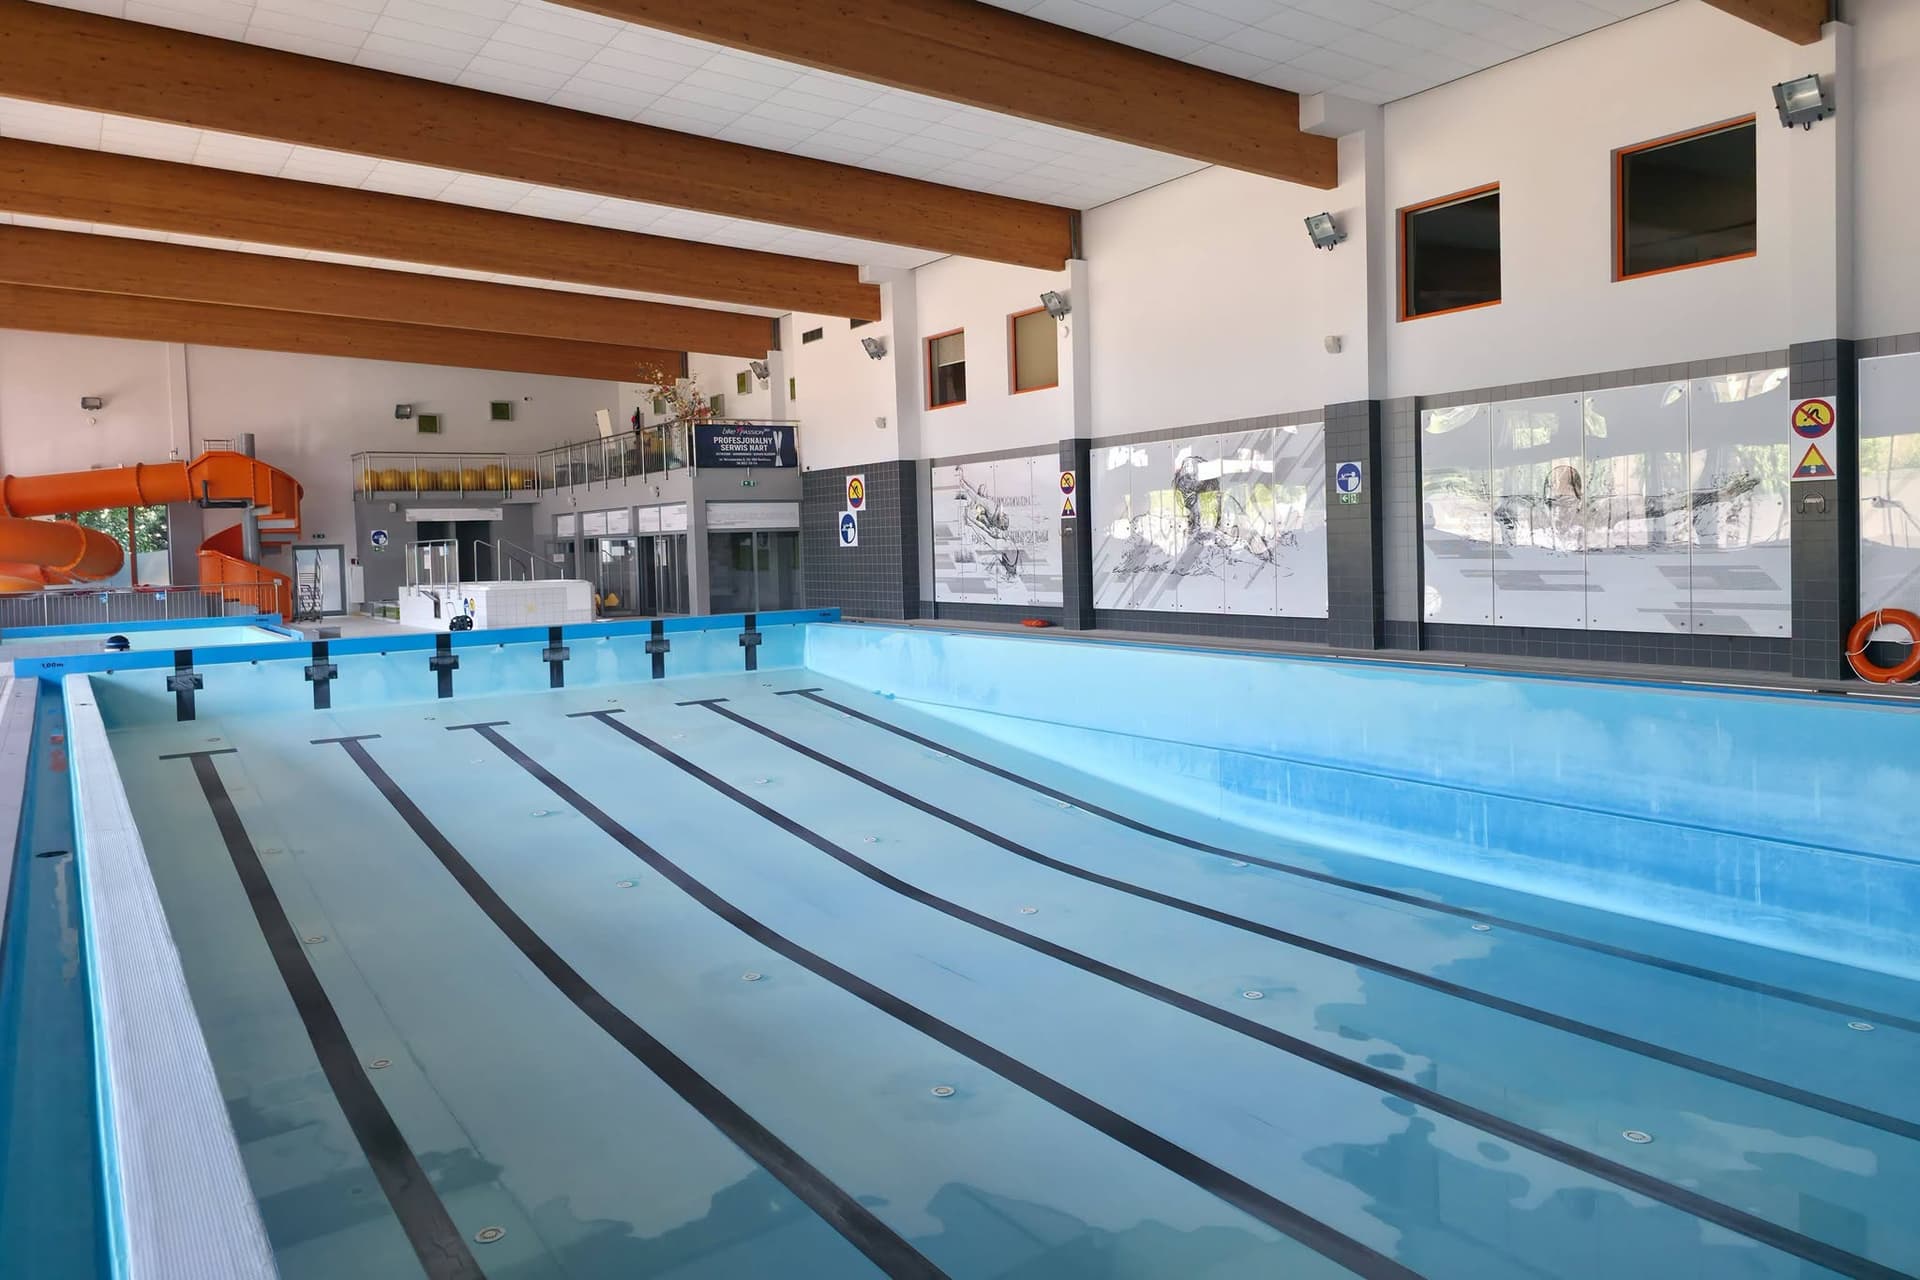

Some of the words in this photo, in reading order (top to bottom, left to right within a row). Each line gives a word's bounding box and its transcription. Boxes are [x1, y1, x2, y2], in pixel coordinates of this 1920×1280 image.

[713, 436, 773, 445] PROFESJONALNY
[720, 444, 748, 452] SERWIS
[749, 444, 768, 452] NART
